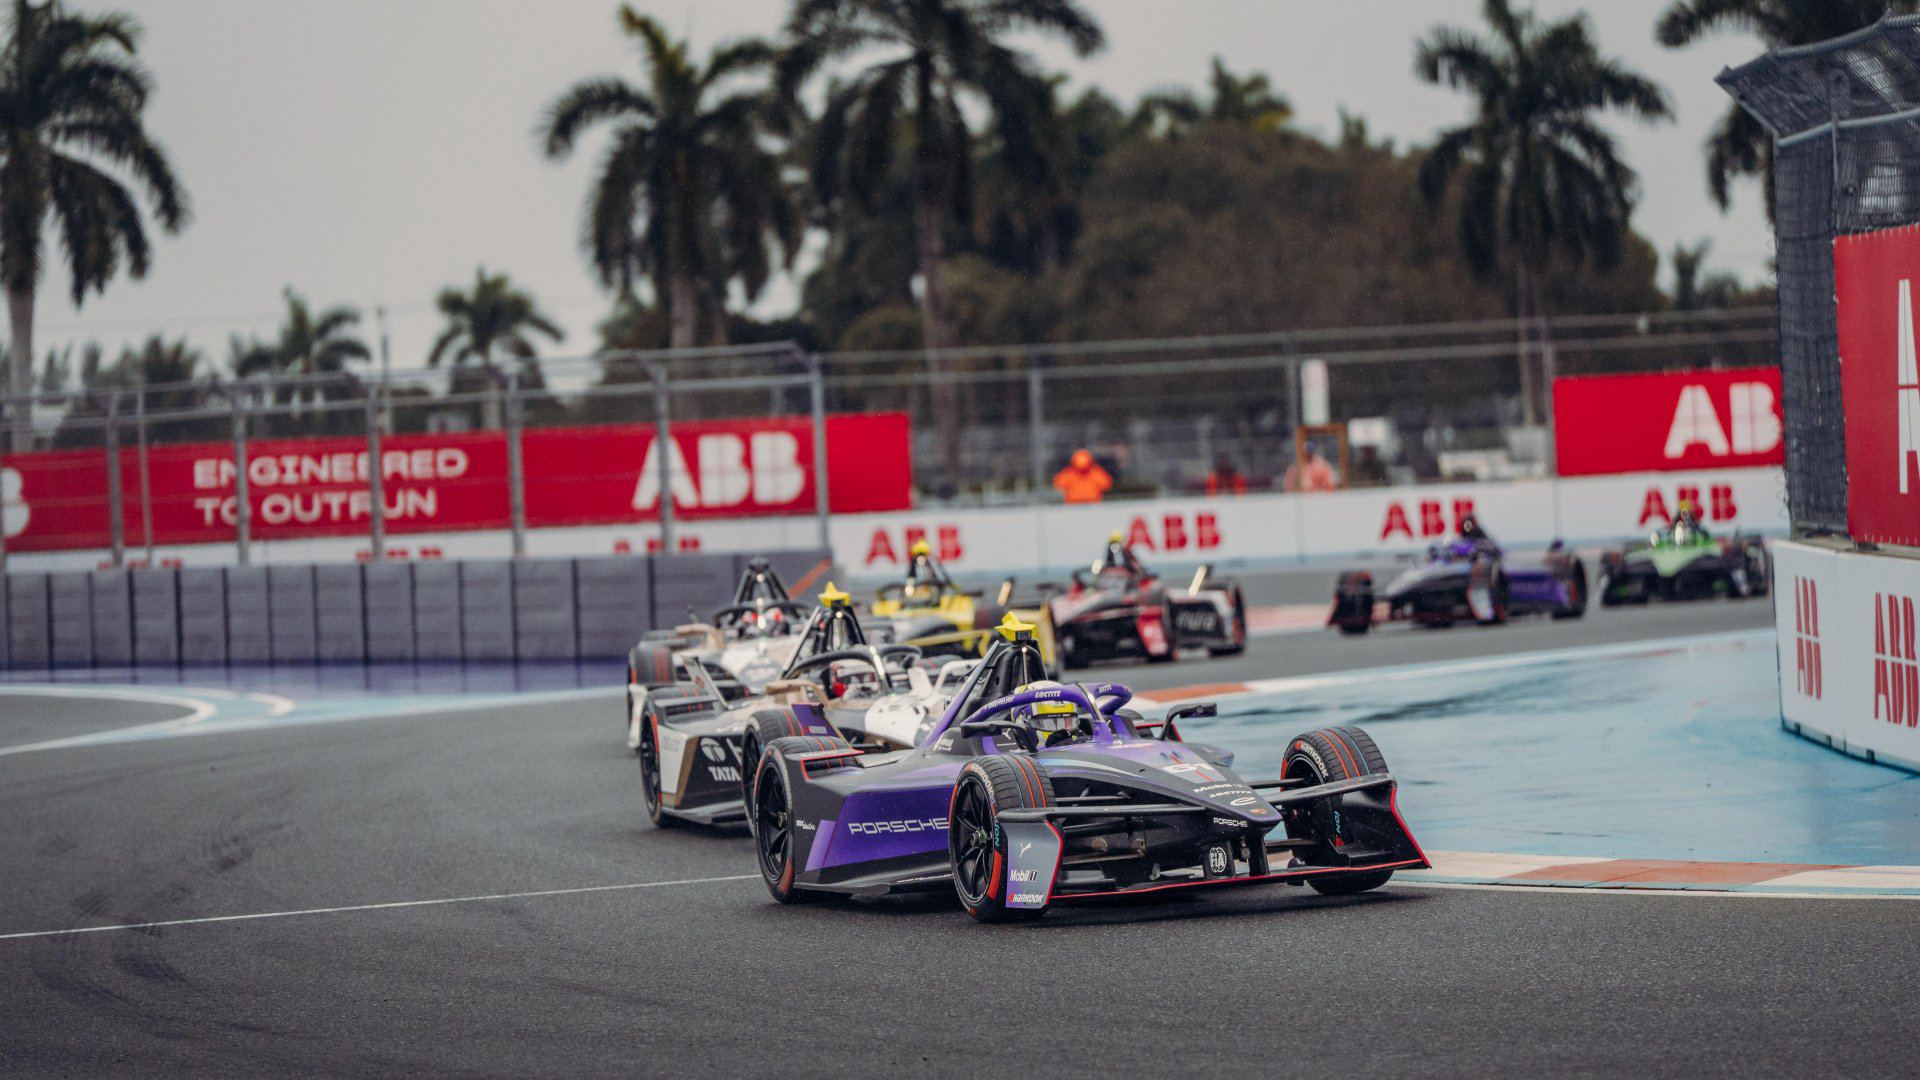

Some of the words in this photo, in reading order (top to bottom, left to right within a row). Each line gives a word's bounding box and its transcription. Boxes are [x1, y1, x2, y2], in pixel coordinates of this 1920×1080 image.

[193, 447, 468, 490] ENGINEERED
[631, 431, 806, 511] ABB
[193, 495, 252, 526] TO
[260, 487, 438, 526] OUTRUN
[1381, 498, 1474, 539] ABB
[1639, 485, 1737, 526] ABB
[865, 526, 964, 566] ABB
[1125, 513, 1221, 553] ABB
[1795, 575, 1822, 701] ABB
[1874, 592, 1919, 728] ABB
[1034, 690, 1062, 699] LOCTITE
[708, 766, 741, 782] TATA
[847, 817, 950, 835] PORSCHE
[1213, 817, 1249, 828] PORSCHE
[1010, 869, 1030, 882] Mobil
